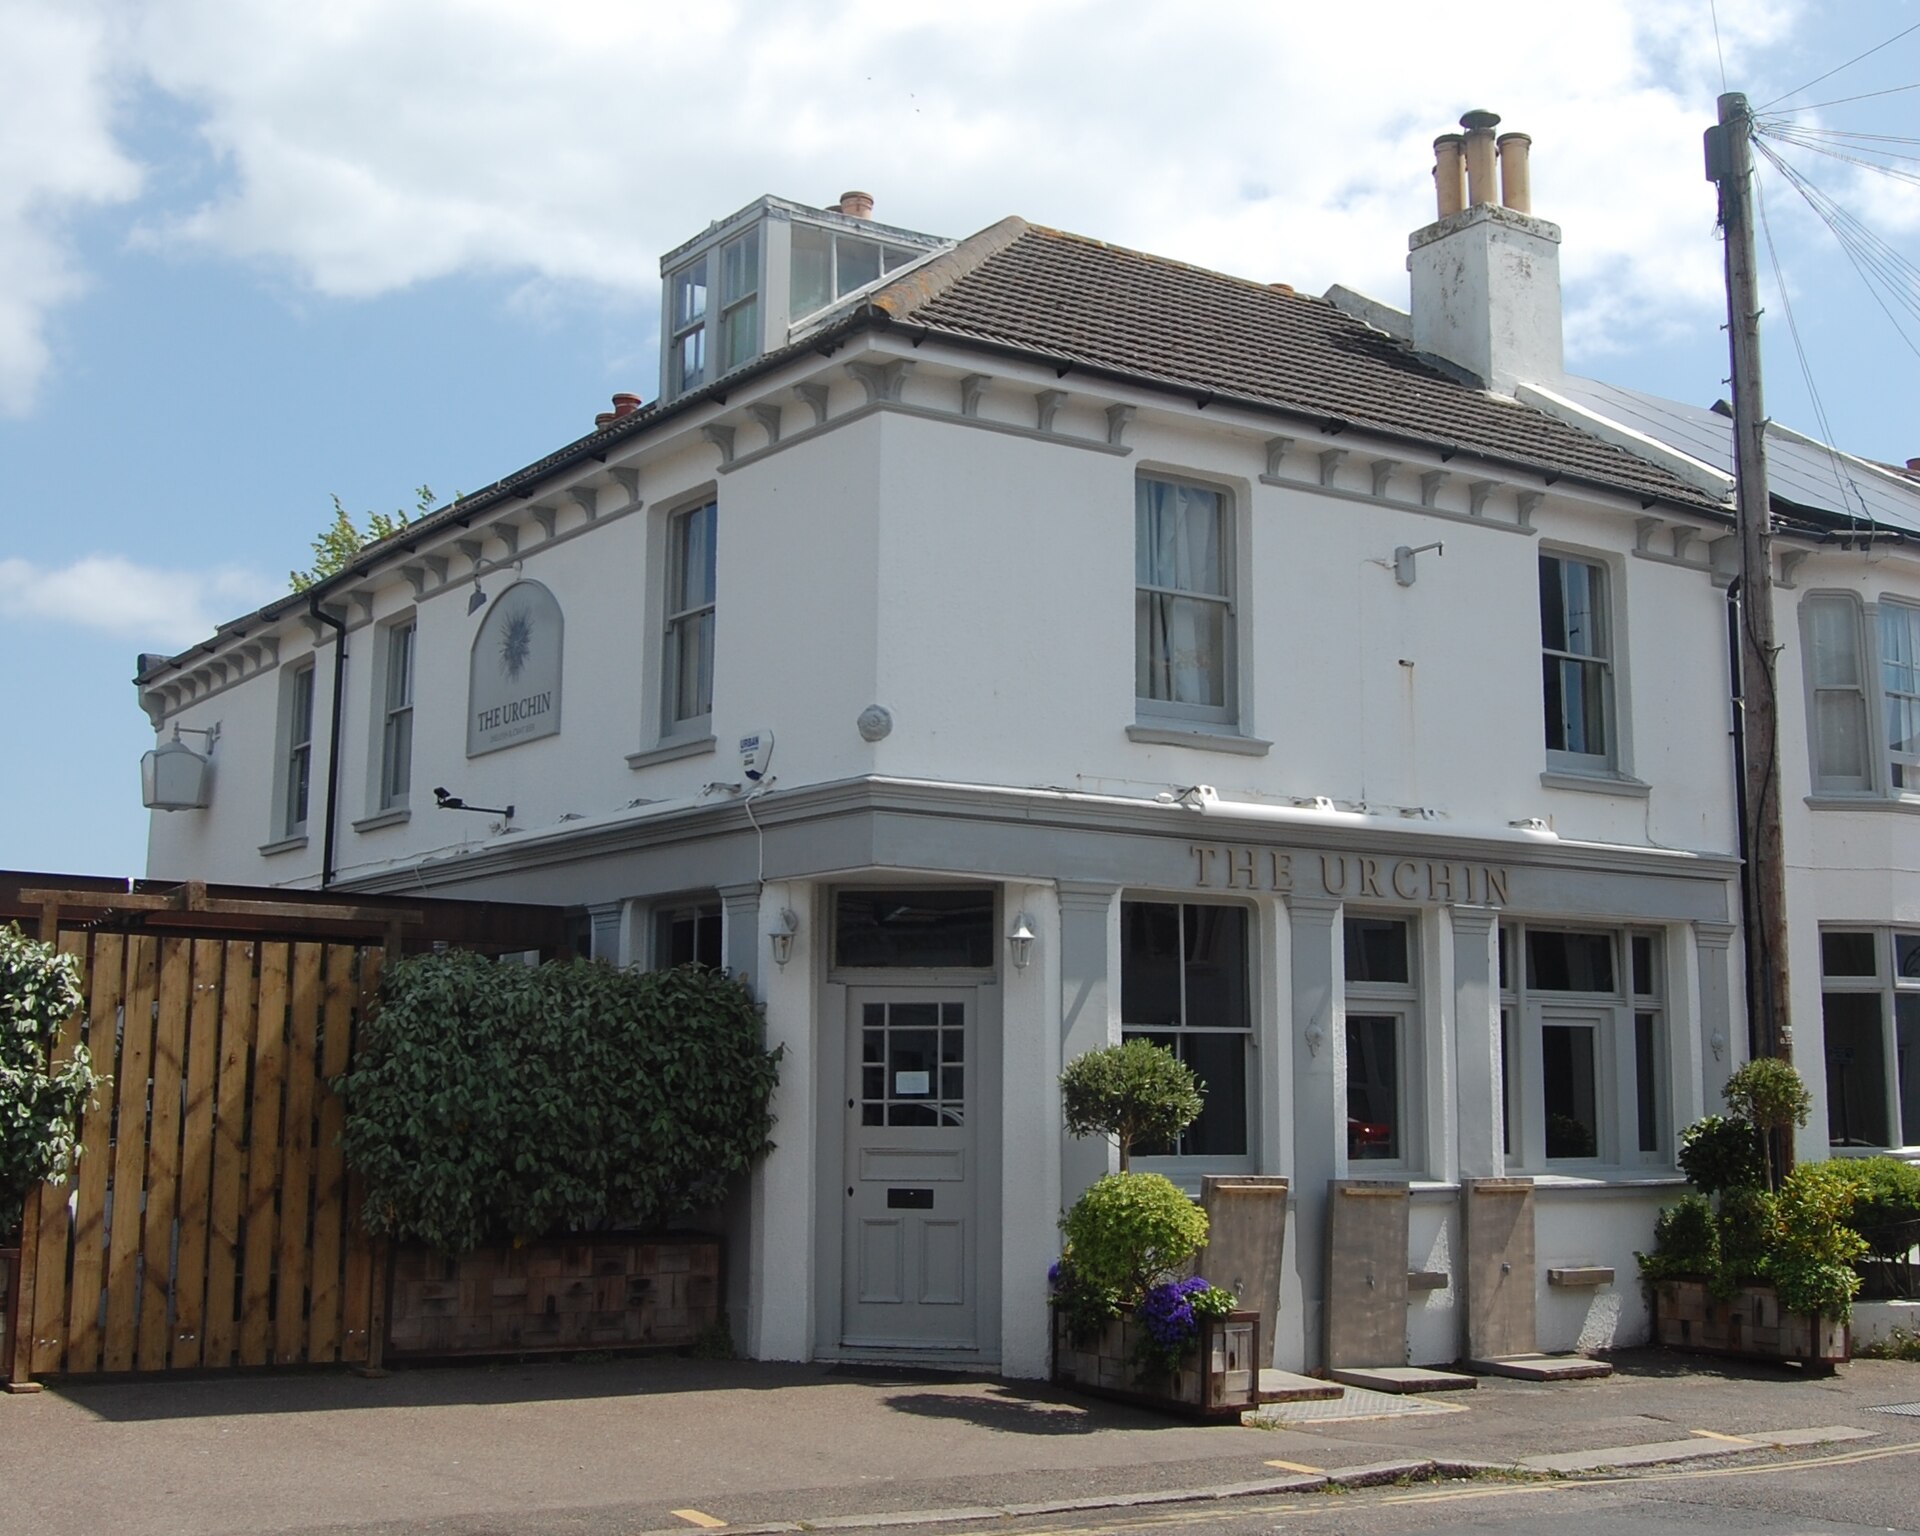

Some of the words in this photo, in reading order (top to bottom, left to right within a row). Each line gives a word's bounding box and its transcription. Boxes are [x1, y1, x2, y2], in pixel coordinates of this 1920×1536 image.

[478, 707, 500, 732] THE
[503, 691, 551, 724] URCHIN
[1190, 846, 1294, 892] THE
[1320, 854, 1509, 905] URCHIN
